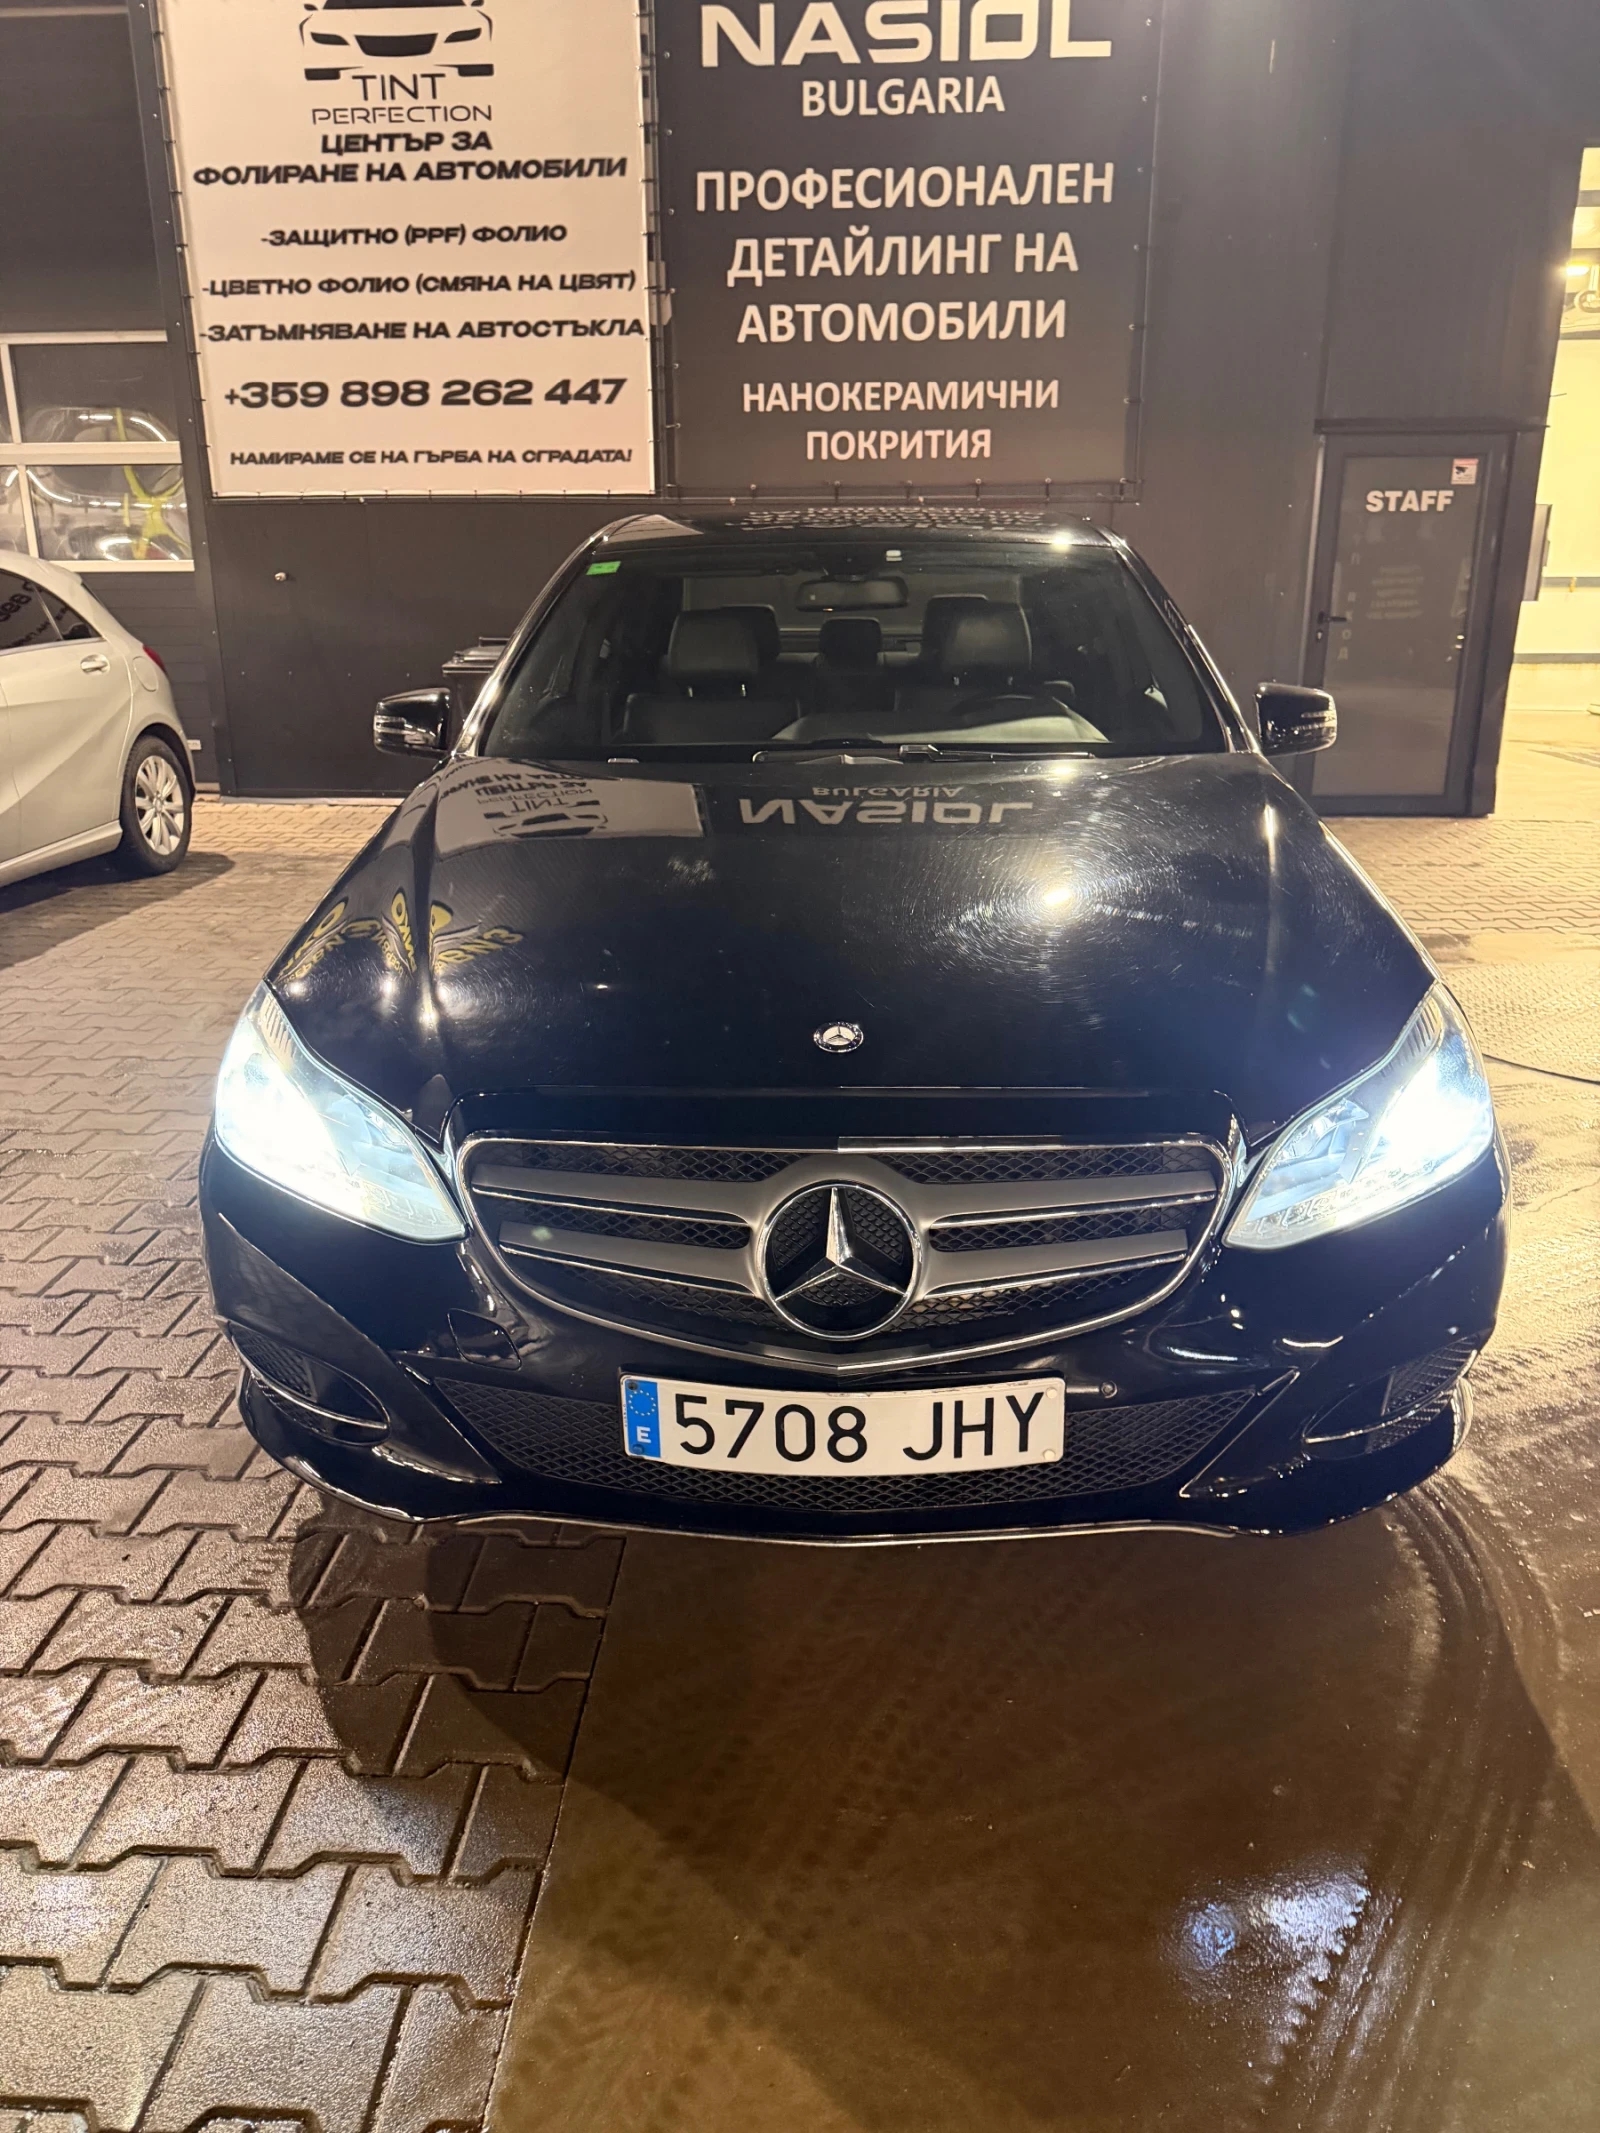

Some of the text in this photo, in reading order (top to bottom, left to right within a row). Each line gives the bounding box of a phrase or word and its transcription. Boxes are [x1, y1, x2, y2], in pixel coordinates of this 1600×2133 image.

[702, 0, 1112, 66] NASIOL
[352, 73, 446, 101] TINT
[803, 76, 1005, 116] BULGARIA
[312, 105, 492, 125] PERFECTION
[322, 131, 492, 156] ЦЕНТЪР ЗА
[193, 157, 627, 185] ФОЛИРАНЕ НА АВТОМОБИЛИ
[697, 162, 1114, 211] ПРОФЕСИОНАЛЕН
[262, 224, 567, 247] -ЗАЩИТНО (PPF) ФОЛИО
[727, 225, 1078, 287] ДЕТАЙЛИНГ НА
[203, 270, 636, 298] -ЦВЕТНО ФОЛИО (СМЯНА НА ЦВЯТ)
[199, 319, 644, 342] -ЗАТЪМНЯВАНЕ НА АВТОСТЪКЛА
[737, 300, 1065, 342] АВТОМОБИЛИ
[225, 378, 627, 408] +359 898 262 447
[744, 380, 1058, 412] НАНОКЕРАМИЧНИ
[231, 449, 632, 465] НАМИРАМЕ СЕ НА ГЪРБА НА СГРАДАТА!
[807, 429, 991, 460] ПОКРИТИЯ
[1366, 490, 1454, 512] STAFF
[637, 1392, 1044, 1463] E 5708 JHY
